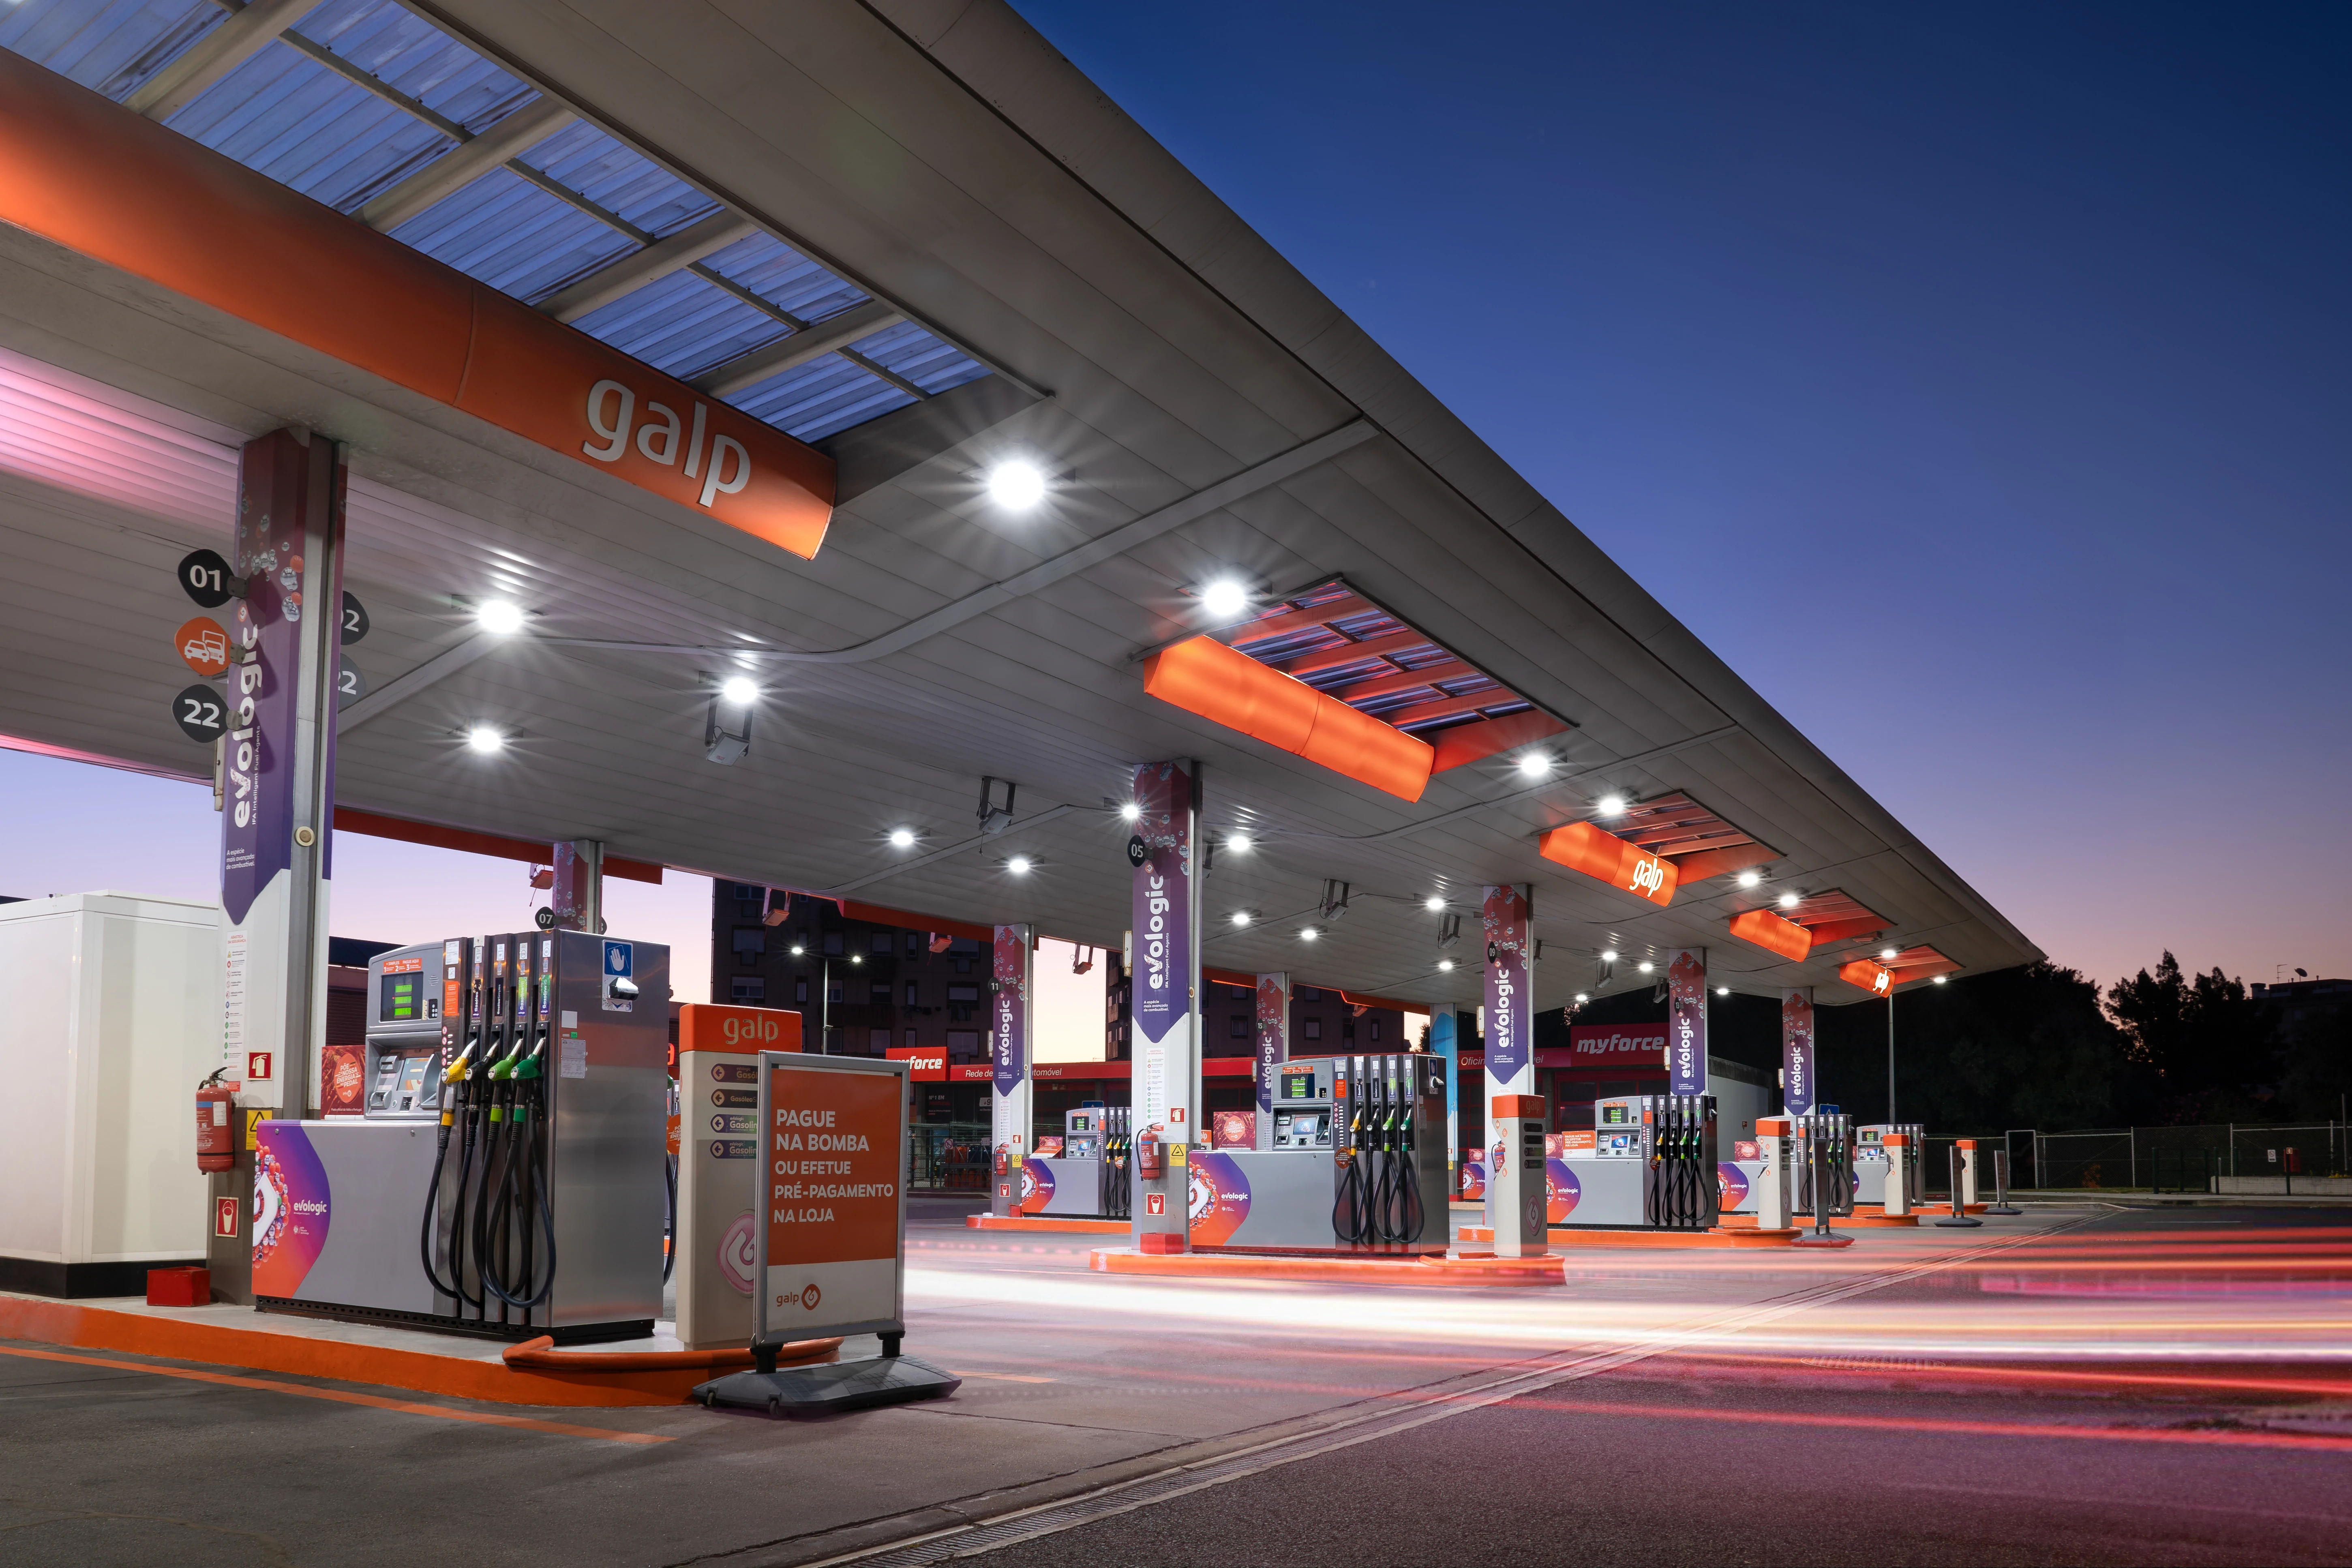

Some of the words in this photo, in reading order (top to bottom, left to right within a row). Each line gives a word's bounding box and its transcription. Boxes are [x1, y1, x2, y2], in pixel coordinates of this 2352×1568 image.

[582, 379, 750, 508] galp
[190, 565, 221, 591] 01
[341, 609, 360, 632] 2
[338, 670, 357, 695] 2
[184, 699, 219, 728] 22
[230, 624, 263, 828] evologic
[1131, 844, 1143, 858] 05
[1629, 858, 1663, 897] galp
[539, 914, 553, 924] 07
[1143, 875, 1170, 989] evologic
[1489, 948, 1495, 956] 09
[1494, 969, 1514, 1047] evologic
[723, 1014, 778, 1045] galp
[999, 1000, 1013, 1066] evologic
[1577, 1034, 1664, 1054] myforce
[1678, 1018, 1694, 1078] evologic
[340, 1063, 350, 1071] PÕE
[893, 1056, 943, 1069] force
[1262, 1036, 1275, 1089] evologic
[1461, 1057, 1485, 1065] Oficin
[336, 1074, 356, 1084] ENERGIA
[342, 1067, 358, 1076] NOSSA
[736, 1071, 757, 1079] Gasól
[1791, 1047, 1804, 1095] evologic
[344, 1079, 358, 1088] PEDAL
[1526, 1099, 1540, 1113] galp
[730, 1120, 757, 1129] Gasolin
[776, 1109, 835, 1127] PAGUE
[730, 1146, 757, 1154] Gasolin
[776, 1135, 803, 1151] NA
[808, 1135, 869, 1151] BOMBA
[775, 1161, 797, 1175] OU
[801, 1161, 851, 1174] EFETUE
[775, 1181, 893, 1199] PRÉ-PAGAMENTO
[1221, 1192, 1248, 1201] evologic
[293, 1199, 327, 1215] evologic
[774, 1210, 795, 1223] NA
[799, 1208, 834, 1222] LOJA
[776, 1292, 799, 1307] galp
